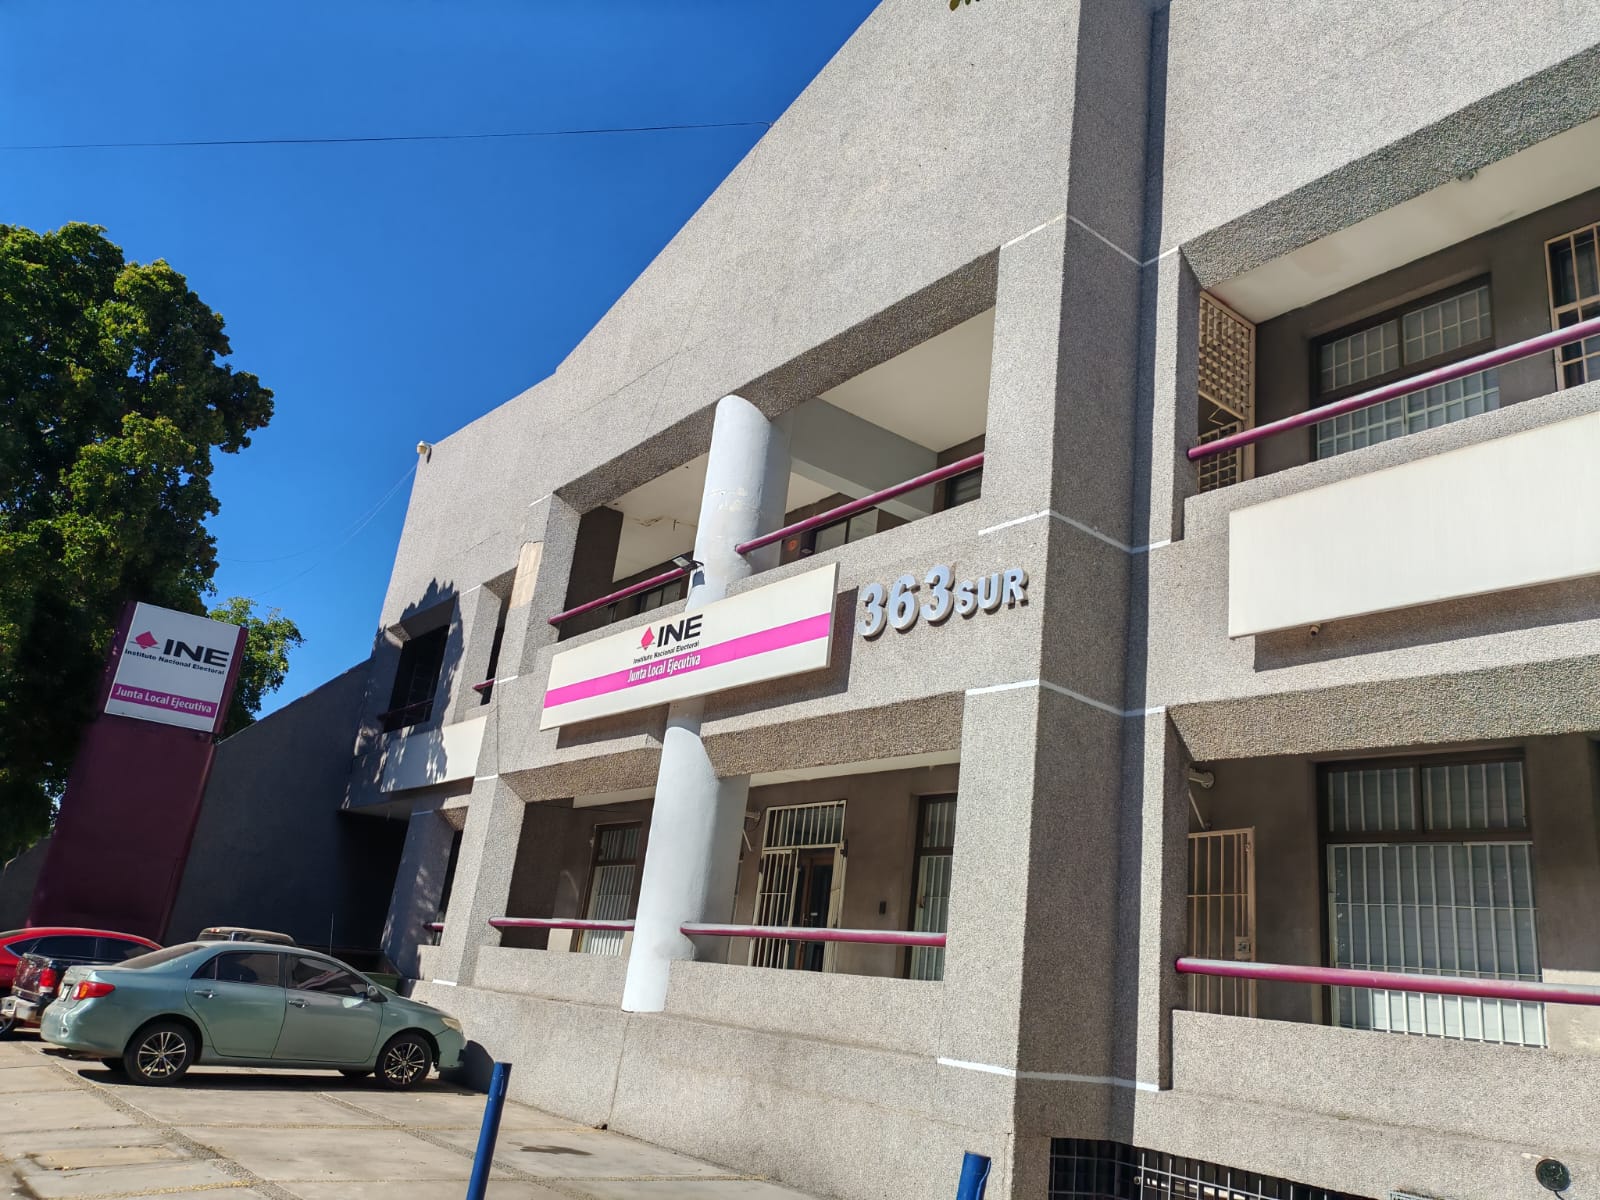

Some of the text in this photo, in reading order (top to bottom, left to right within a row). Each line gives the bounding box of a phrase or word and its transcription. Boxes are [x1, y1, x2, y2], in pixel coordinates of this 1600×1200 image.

[857, 564, 1027, 636] 363 SUR
[657, 614, 703, 648] INE
[124, 649, 225, 675] Instituto Nacional Electoral
[163, 638, 229, 667] INE
[633, 640, 699, 664] Instituto Nacional Electoral
[627, 654, 700, 683] Junta Local Ejecutiva
[116, 686, 212, 713] Junta Local Ejecutiva
